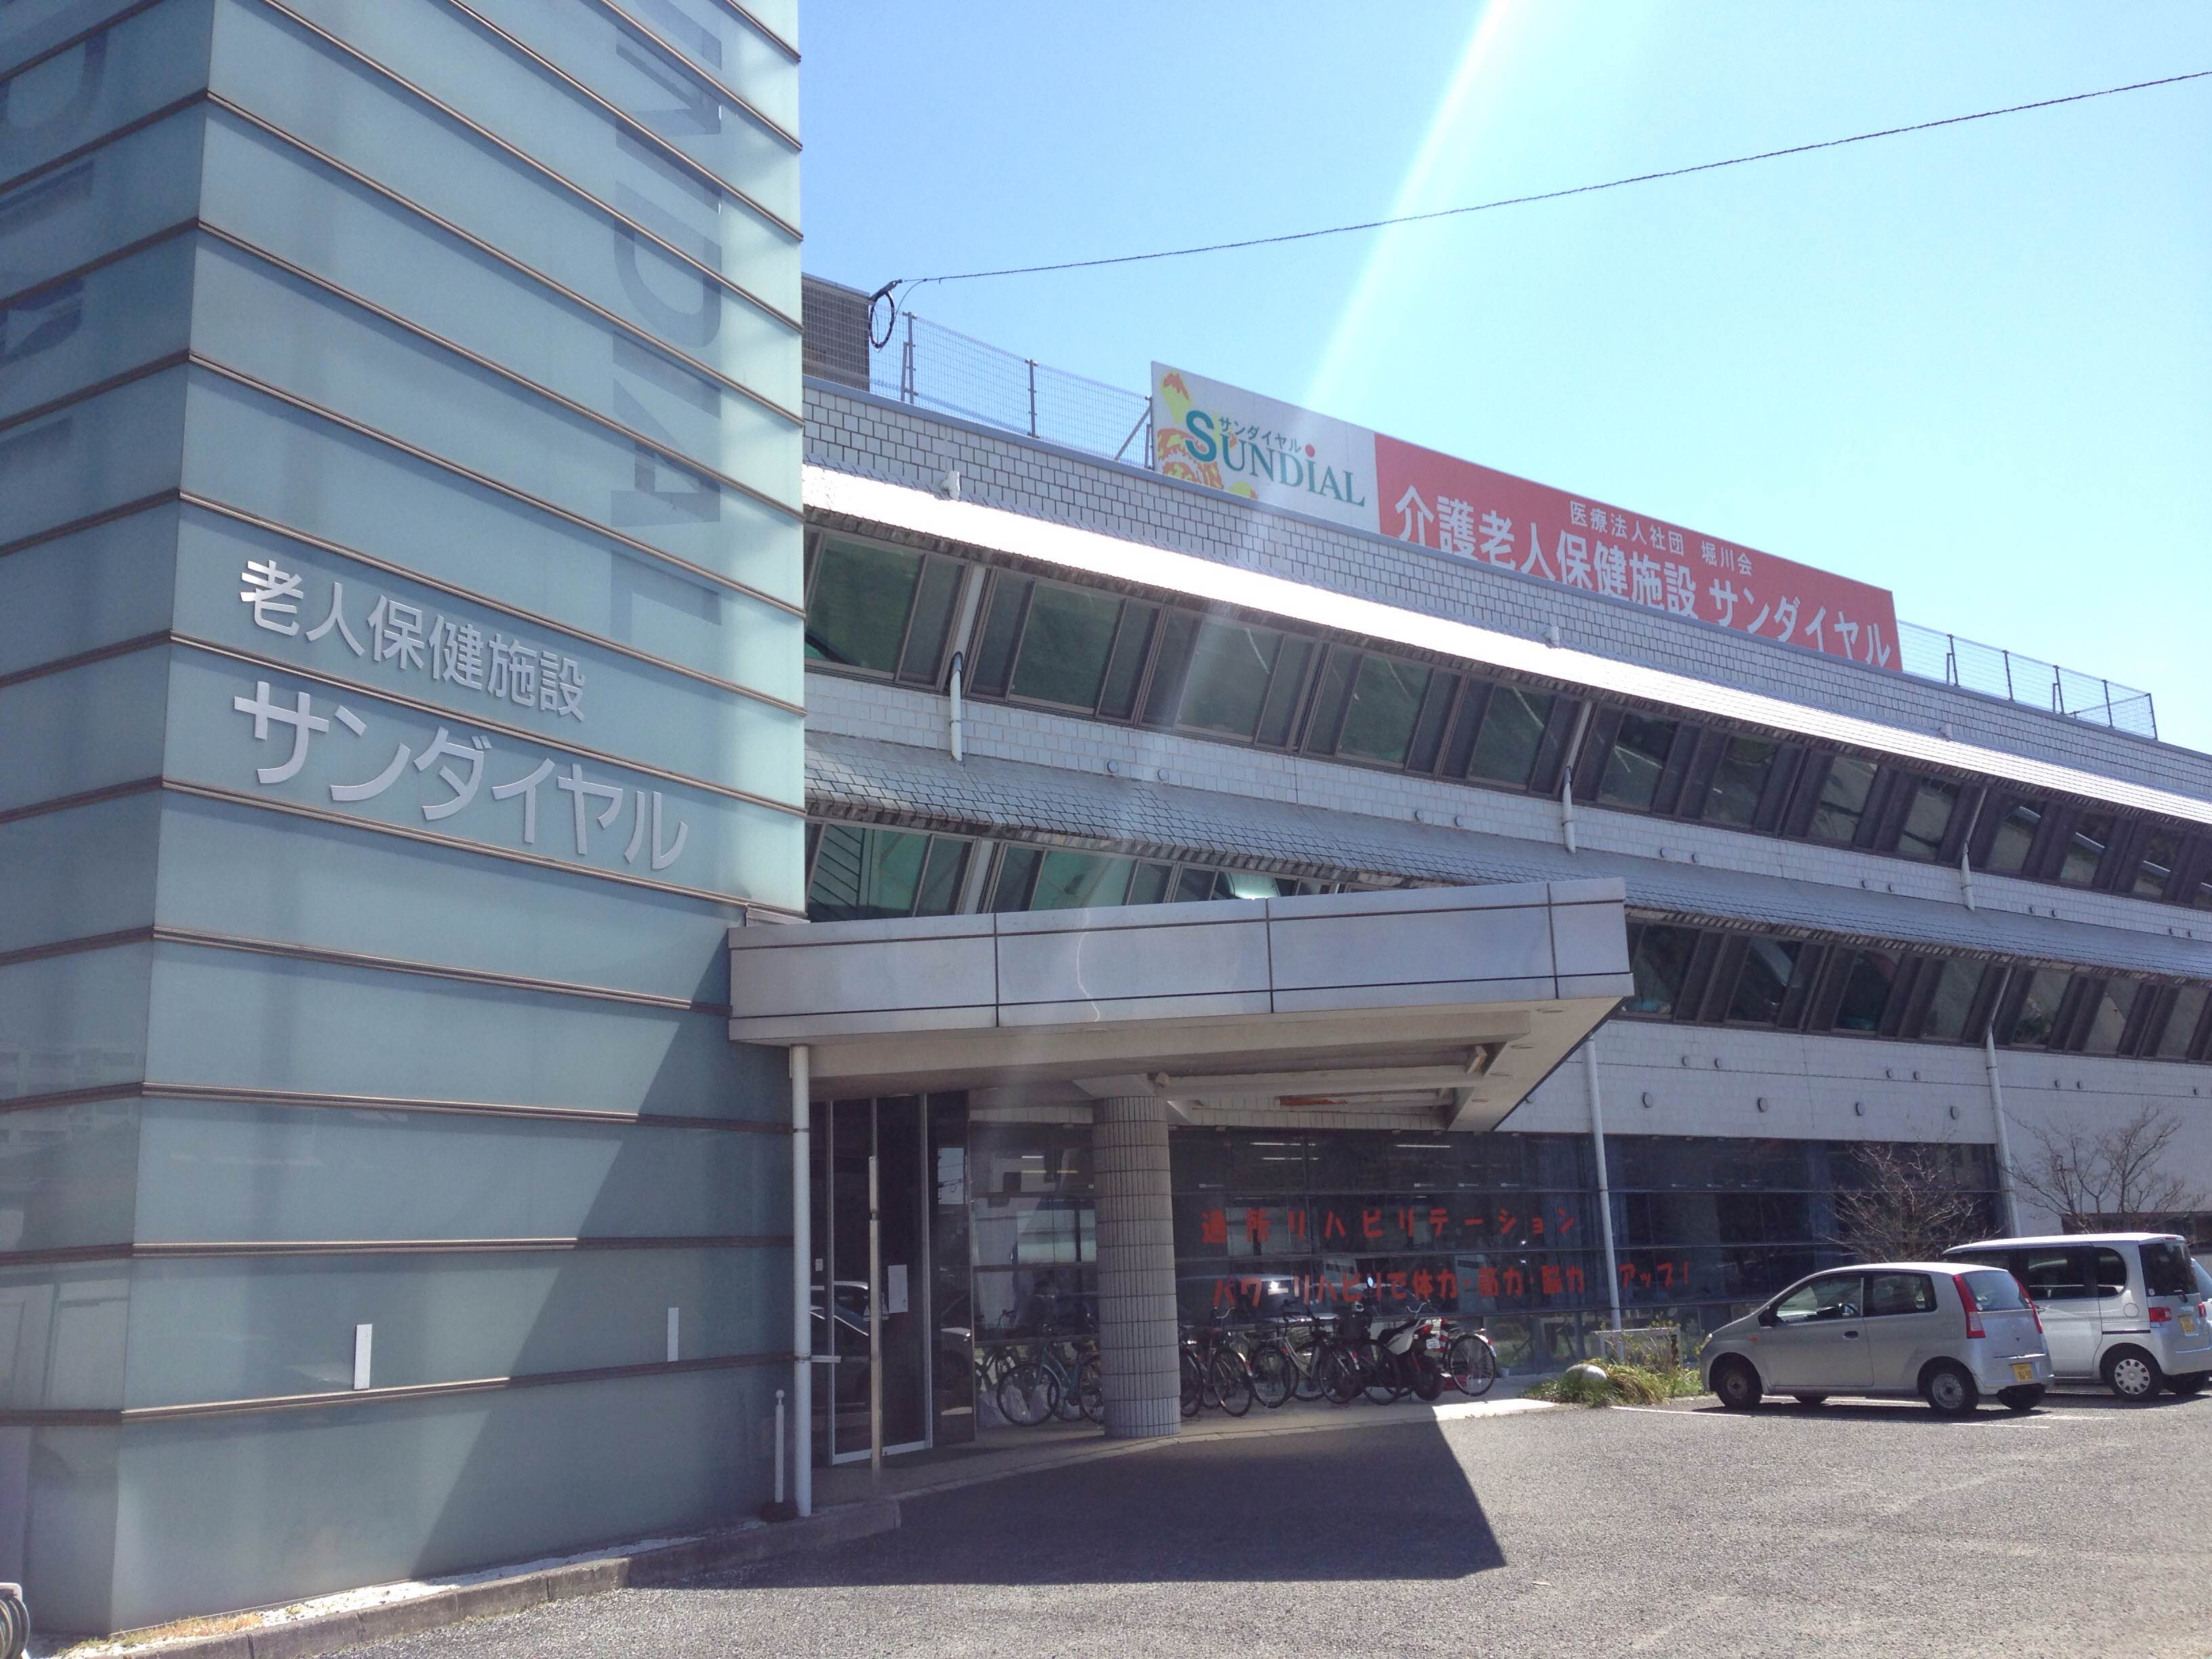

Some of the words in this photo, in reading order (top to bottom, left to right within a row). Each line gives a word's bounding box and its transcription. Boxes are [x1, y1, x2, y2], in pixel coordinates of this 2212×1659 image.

[1185, 410, 1365, 507] SUNDIAL
[1218, 416, 1301, 453] サンダイヤル
[1395, 485, 1698, 619] 介護老人保健施設
[1709, 578, 1891, 667] サンダイヤル
[1570, 500, 1685, 556] 医療法人社団
[1701, 540, 1752, 576] 堀川会
[239, 559, 586, 722] 老人保健施設
[233, 681, 688, 871] サンダイヤル
[1202, 1207, 1576, 1244] 通所リハビリテーション
